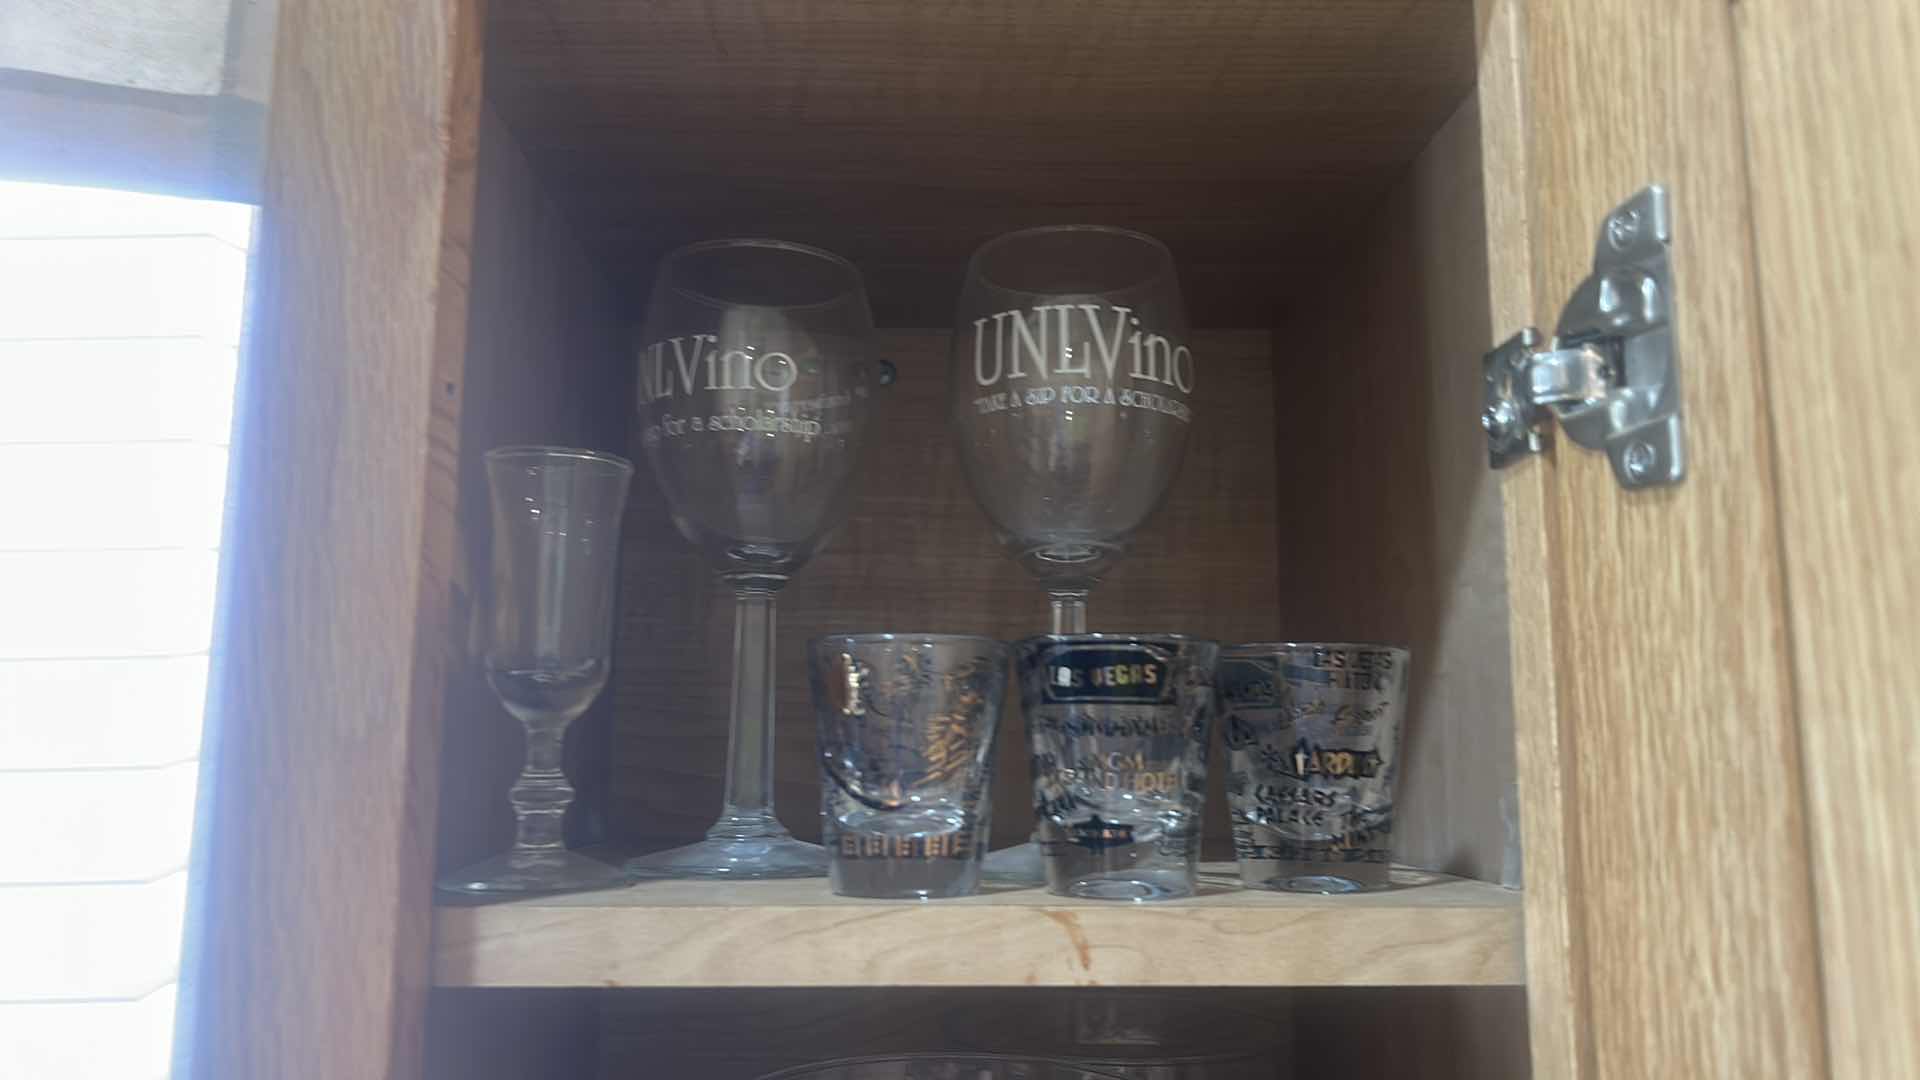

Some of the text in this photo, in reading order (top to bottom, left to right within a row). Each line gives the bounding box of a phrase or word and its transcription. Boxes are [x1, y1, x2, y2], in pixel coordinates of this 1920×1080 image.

[973, 304, 1194, 394] UNLVino
[1010, 390, 1023, 409] A
[1061, 385, 1100, 404] FOR
[1103, 386, 1116, 405] A
[690, 416, 705, 432] a
[1091, 663, 1159, 687] VEGAS
